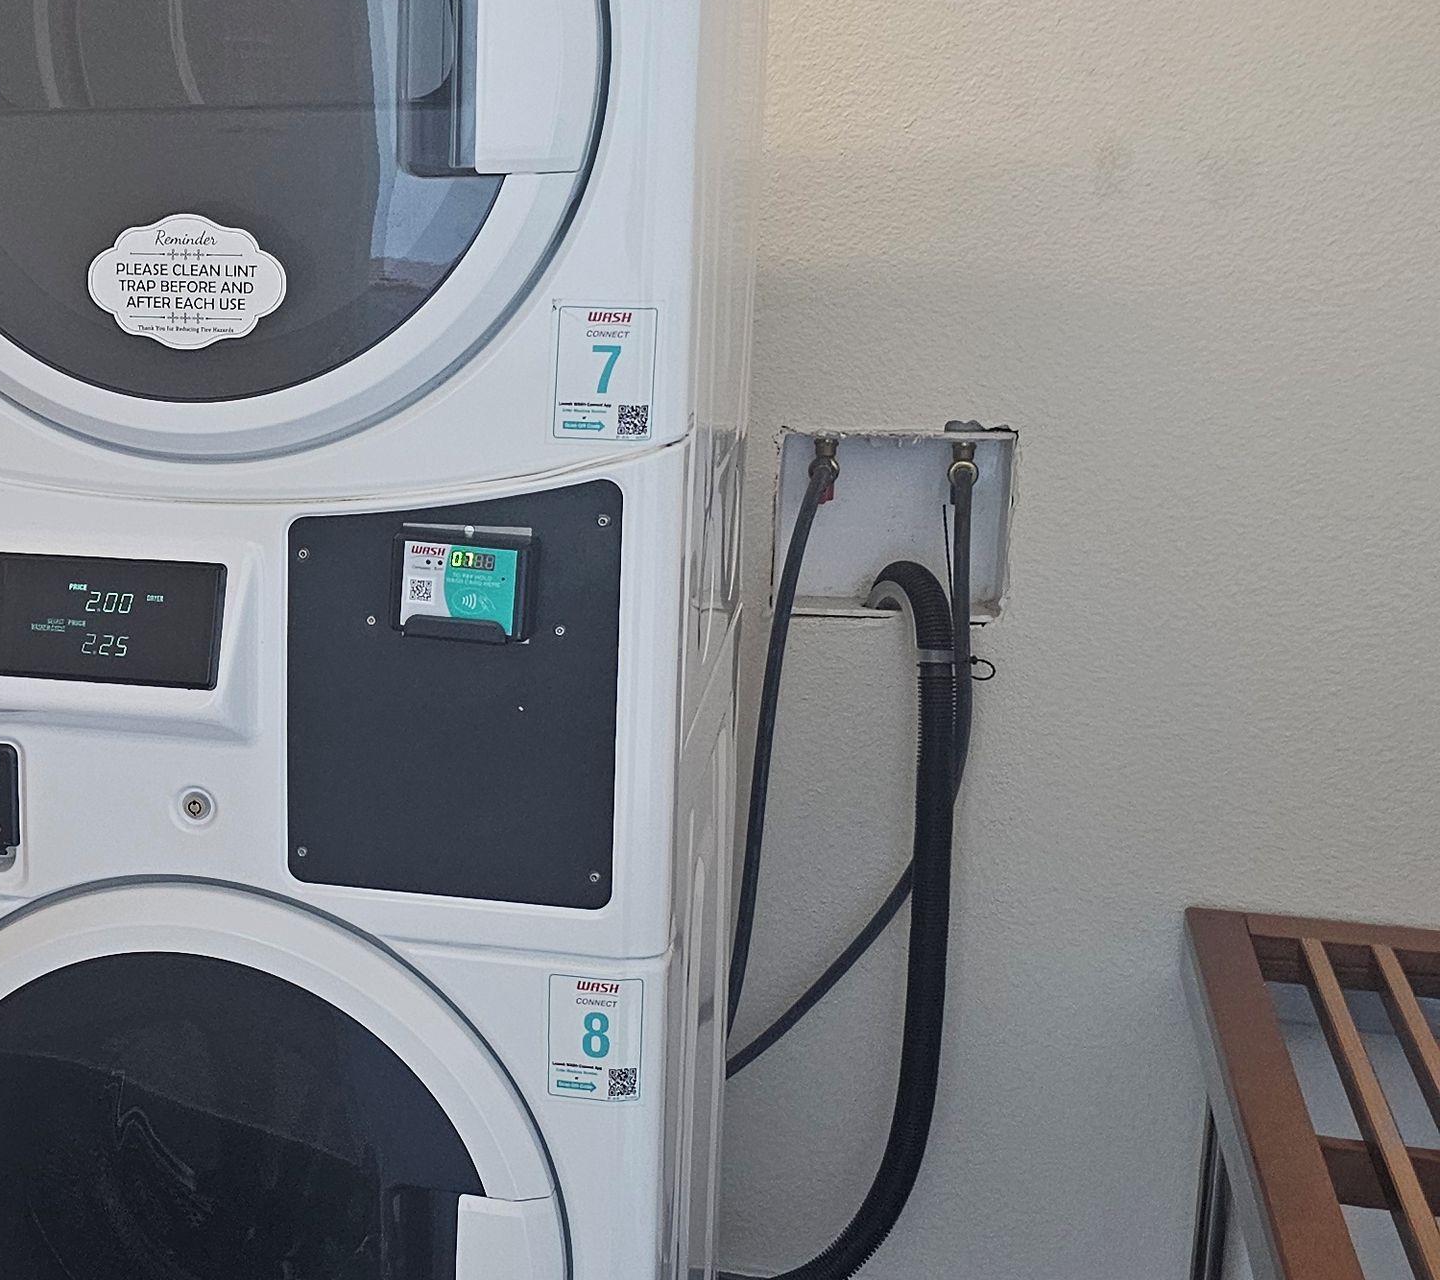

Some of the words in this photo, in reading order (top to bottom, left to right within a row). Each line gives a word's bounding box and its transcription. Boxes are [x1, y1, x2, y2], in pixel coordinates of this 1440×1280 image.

[155, 230, 217, 246] Reminder
[117, 263, 169, 275] PLEASE
[173, 264, 220, 277] CLEAN
[225, 265, 257, 277] LINT
[119, 280, 156, 292] TRAP
[161, 281, 216, 293] BEFORE
[221, 282, 254, 294] AND
[127, 296, 171, 308] AFTER
[175, 297, 215, 309] EACH
[220, 298, 246, 310] USE
[588, 312, 632, 323] WASH
[586, 330, 630, 338] CONNECT
[592, 345, 621, 393] 7
[412, 545, 445, 556] WASH
[452, 551, 474, 567] 07
[69, 583, 87, 591] PRICE
[85, 591, 134, 614] 2.00
[68, 619, 86, 627] PRICE
[81, 633, 129, 657] 2.25
[576, 980, 620, 993] WASH
[576, 997, 617, 1008] CONNECT
[582, 1011, 610, 1058] 8
